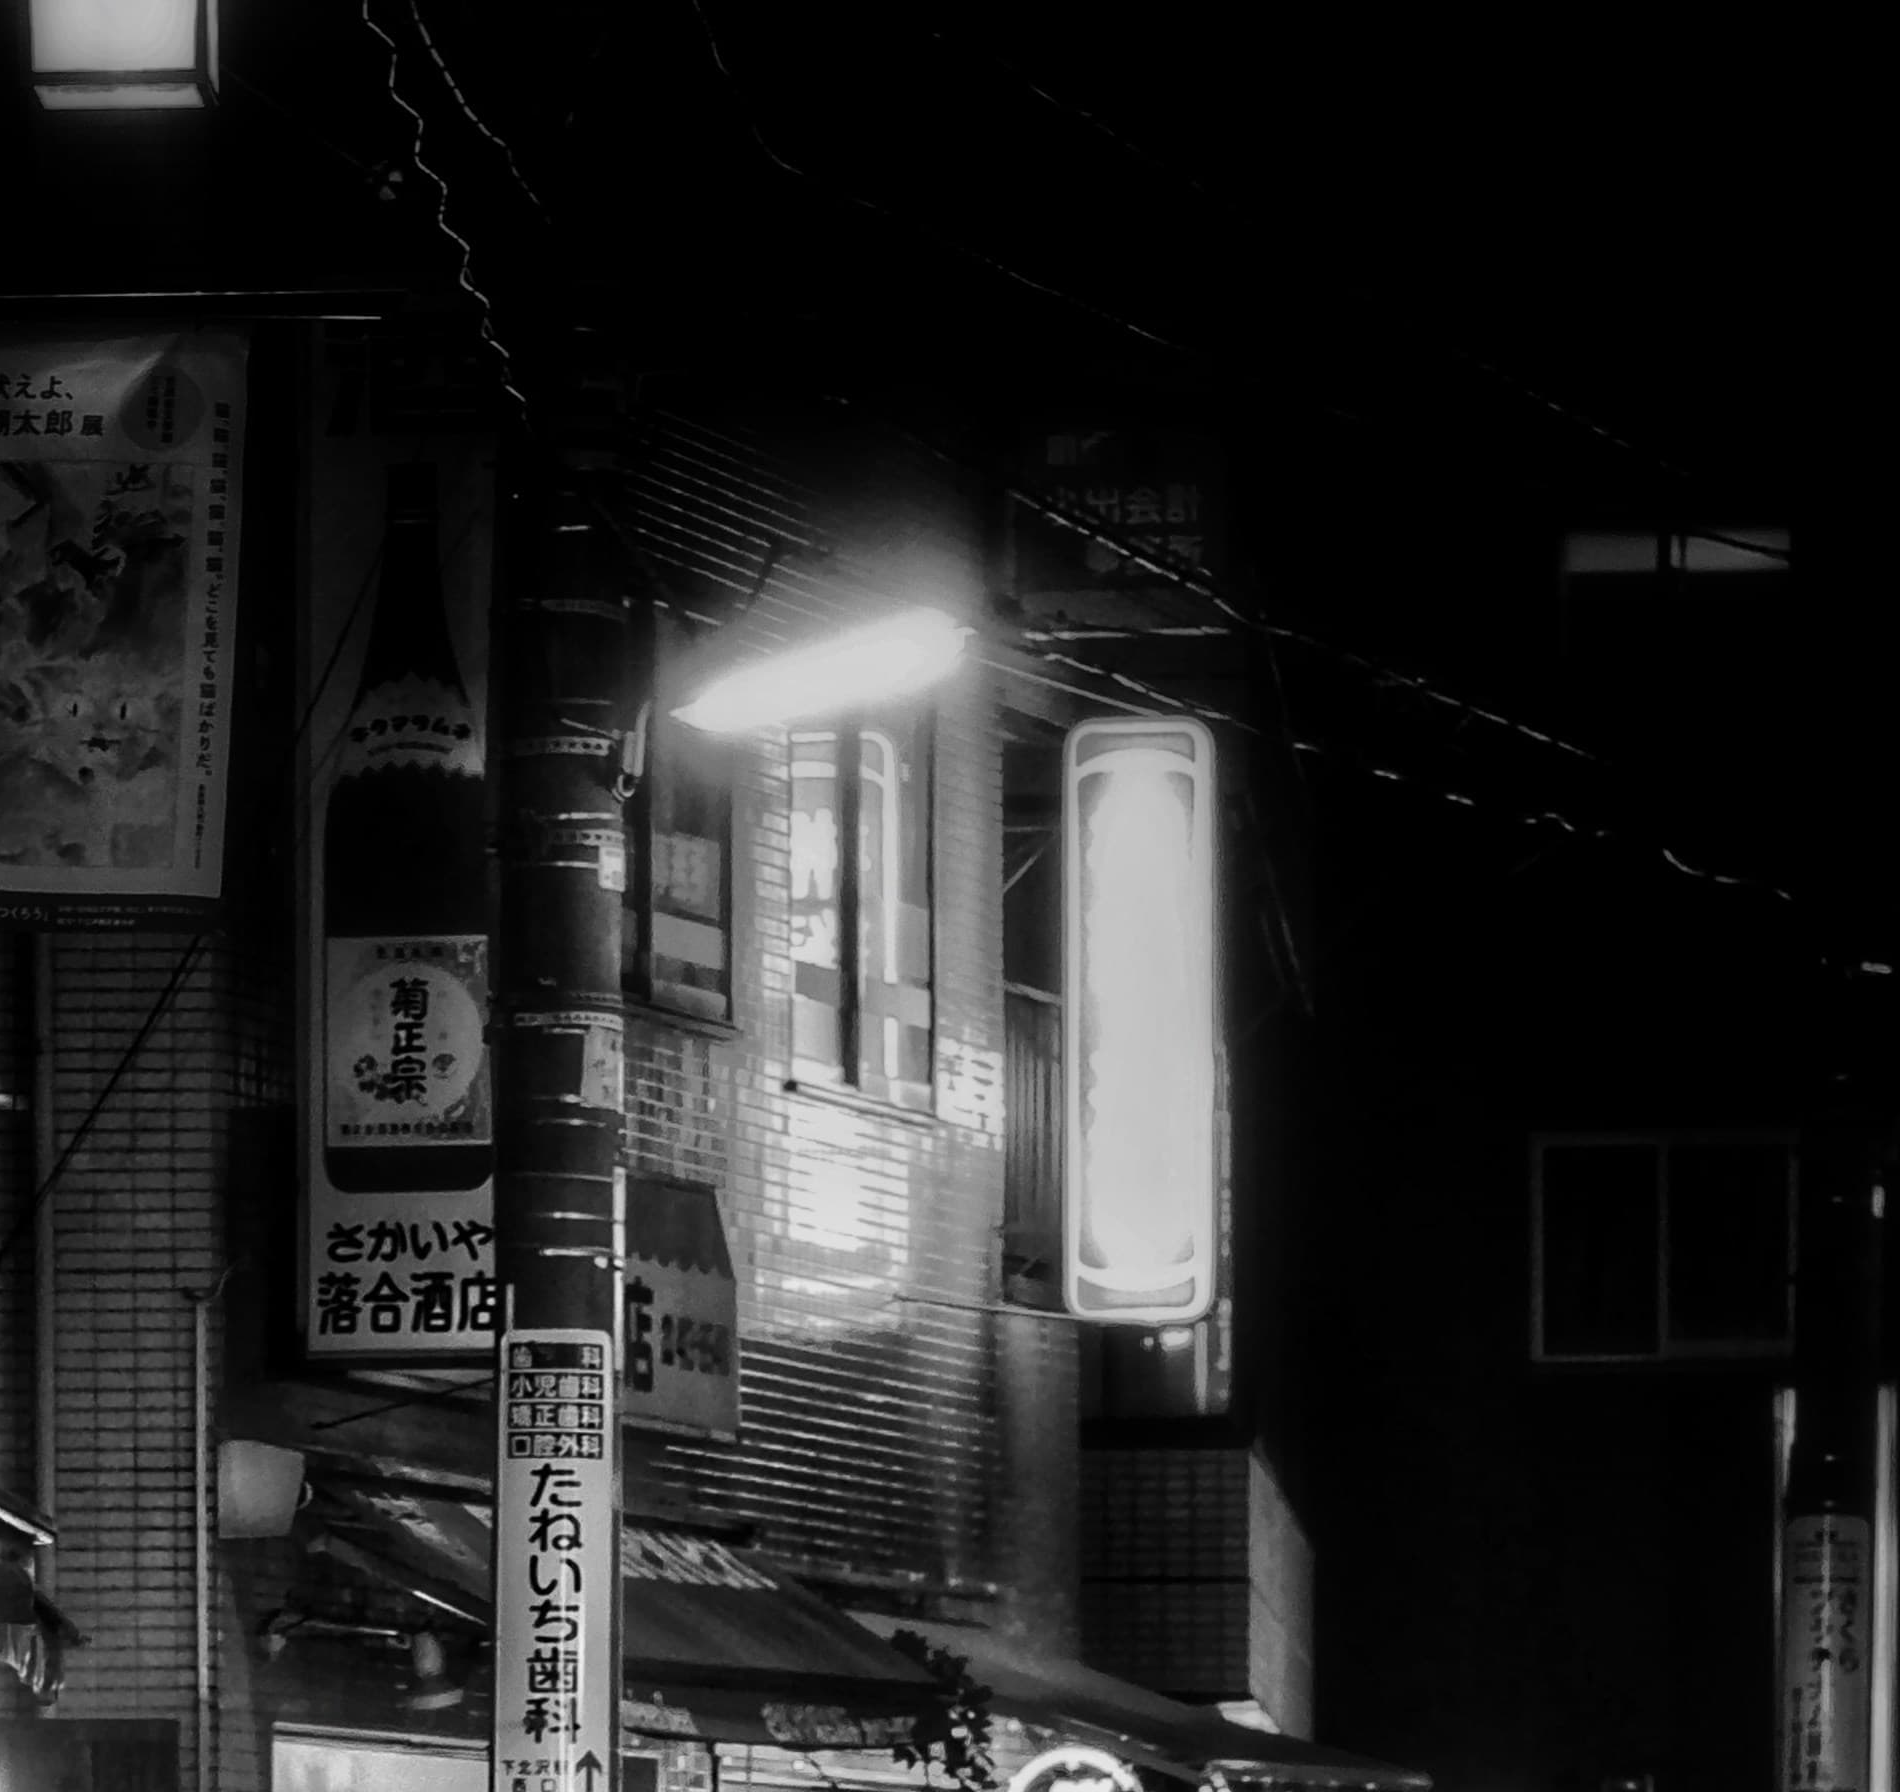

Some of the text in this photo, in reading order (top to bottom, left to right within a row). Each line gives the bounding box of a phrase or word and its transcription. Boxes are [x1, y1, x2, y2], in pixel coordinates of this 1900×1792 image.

[389, 978, 429, 1104] 菊正宗
[326, 1219, 495, 1263] さかいや
[317, 1270, 499, 1335] 落合酒店
[512, 1345, 602, 1369] 歯科
[510, 1374, 602, 1398] 小児歯科
[510, 1403, 602, 1428] 矯正歯科
[510, 1433, 602, 1458] 口腔外科
[525, 1463, 582, 1744] たねいち歯科
